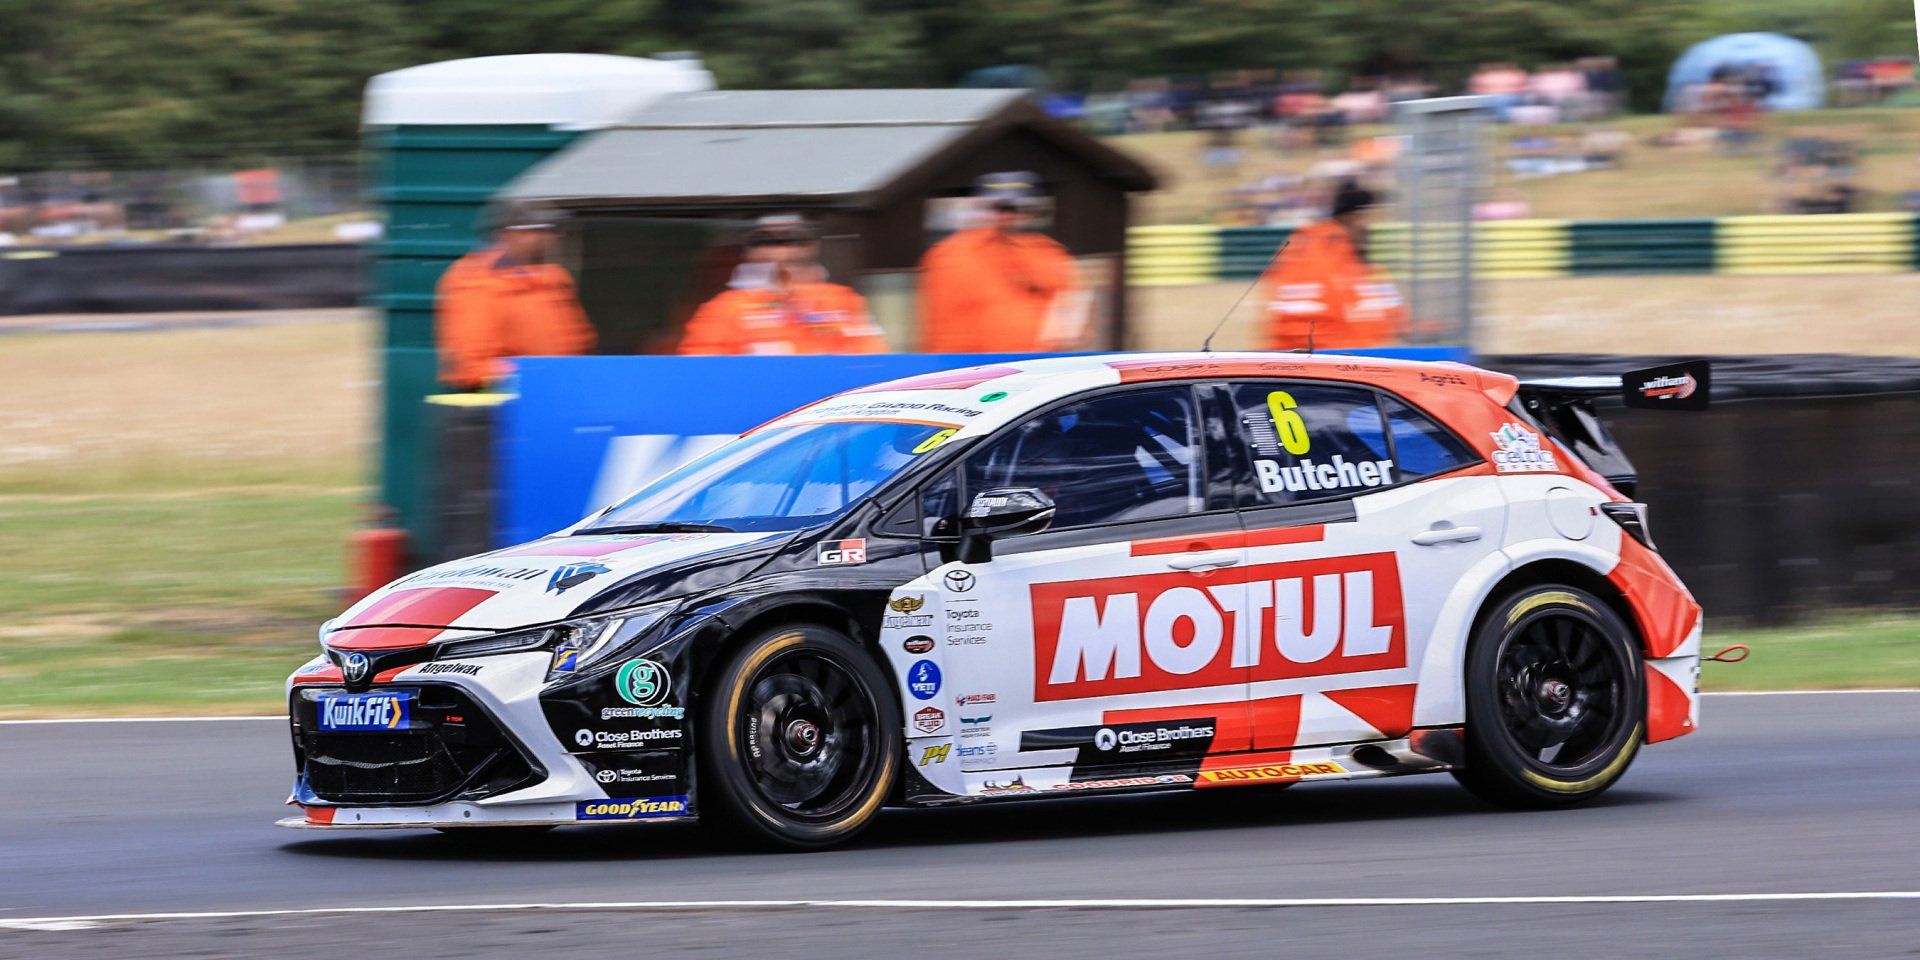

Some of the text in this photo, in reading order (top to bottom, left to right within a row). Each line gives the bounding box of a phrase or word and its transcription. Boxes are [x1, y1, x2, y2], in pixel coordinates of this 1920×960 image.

[926, 403, 983, 417] Racing
[1267, 391, 1311, 455] 6
[912, 428, 959, 455] 6
[1253, 454, 1394, 494] Butcher
[821, 548, 865, 564] GR
[945, 609, 980, 621] Toyota
[946, 623, 993, 633] Insurance
[1048, 570, 1394, 685] MOTUL
[947, 635, 987, 646] Services
[419, 663, 485, 676] Angelwax
[912, 682, 936, 692] YETI
[595, 728, 683, 743] Close Brothers
[1118, 726, 1214, 745] Close Brothers
[597, 740, 645, 749] Asset Finance
[1119, 742, 1172, 753] Asset Finance
[621, 768, 642, 777] Toyota
[621, 773, 677, 782] Insurance Services
[1214, 764, 1337, 782] AUTOCAR
[586, 799, 682, 817] GOODYEAR
